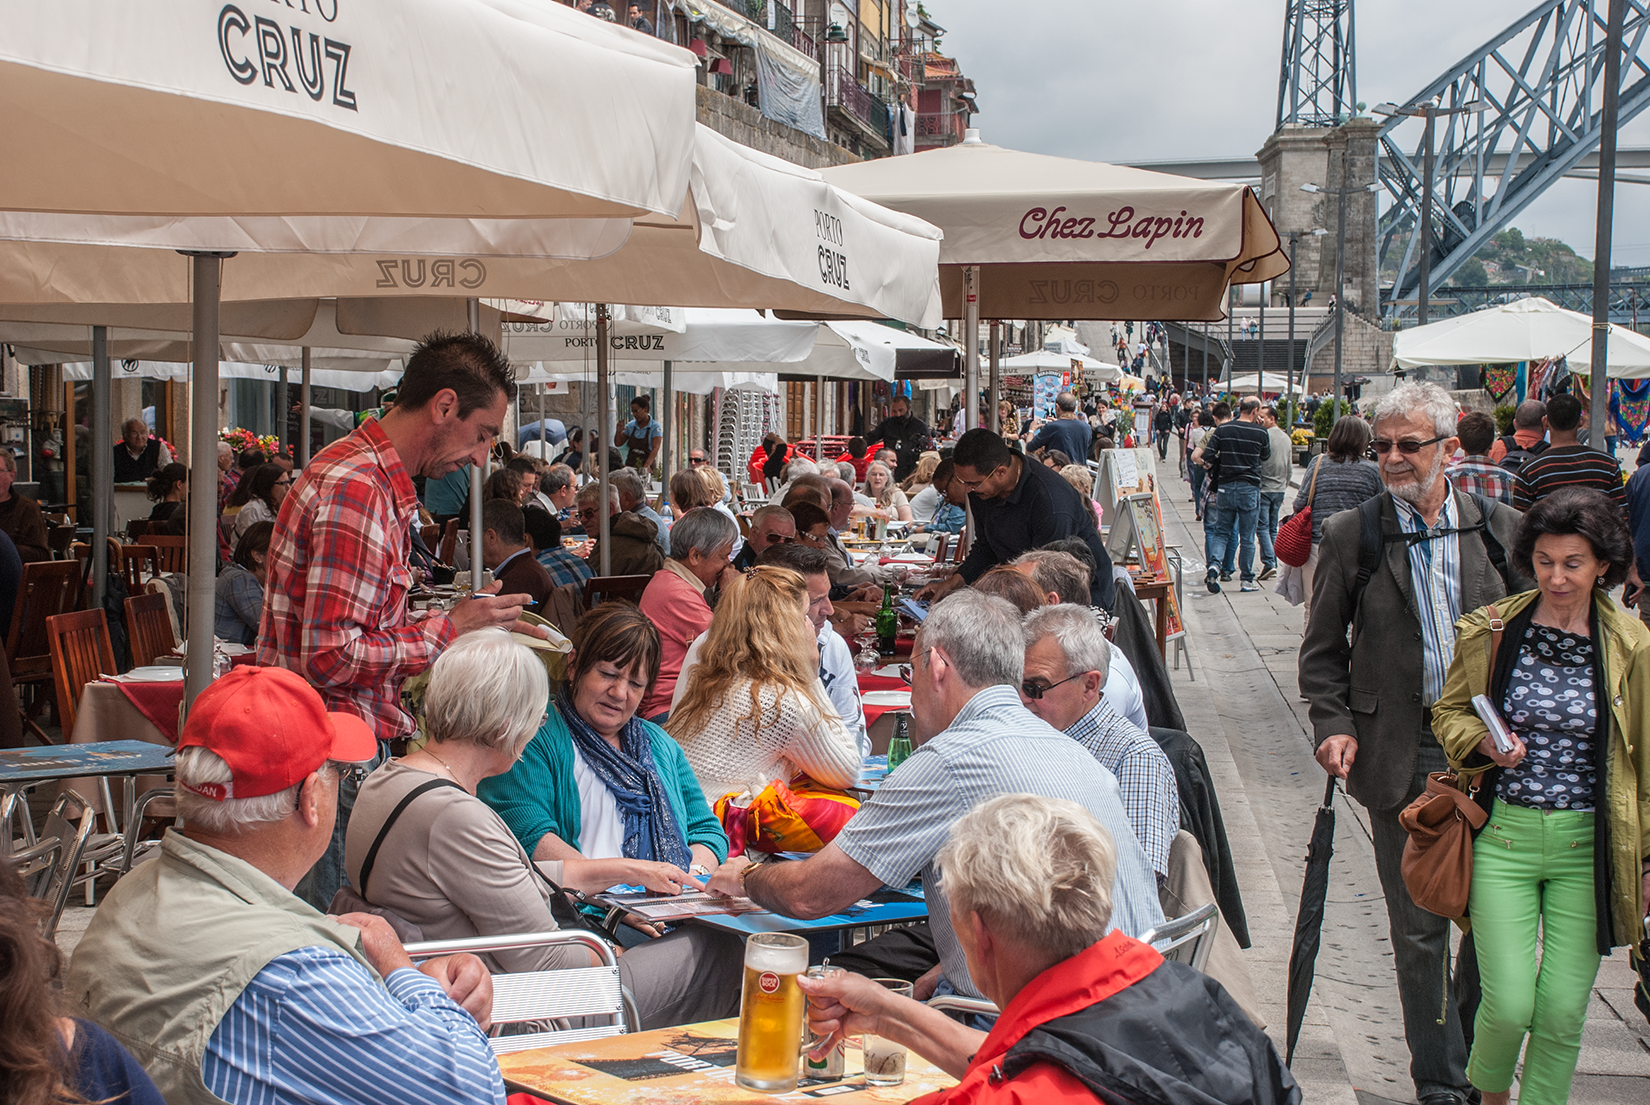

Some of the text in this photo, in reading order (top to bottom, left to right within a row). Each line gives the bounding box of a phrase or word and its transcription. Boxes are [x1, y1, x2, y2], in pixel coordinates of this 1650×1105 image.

[217, 4, 358, 111] CRUZ
[814, 209, 843, 246] PORTO
[1018, 206, 1204, 249] Chez Lapin
[818, 245, 850, 290] CRUZ
[565, 335, 664, 350] PORT CRUZ
